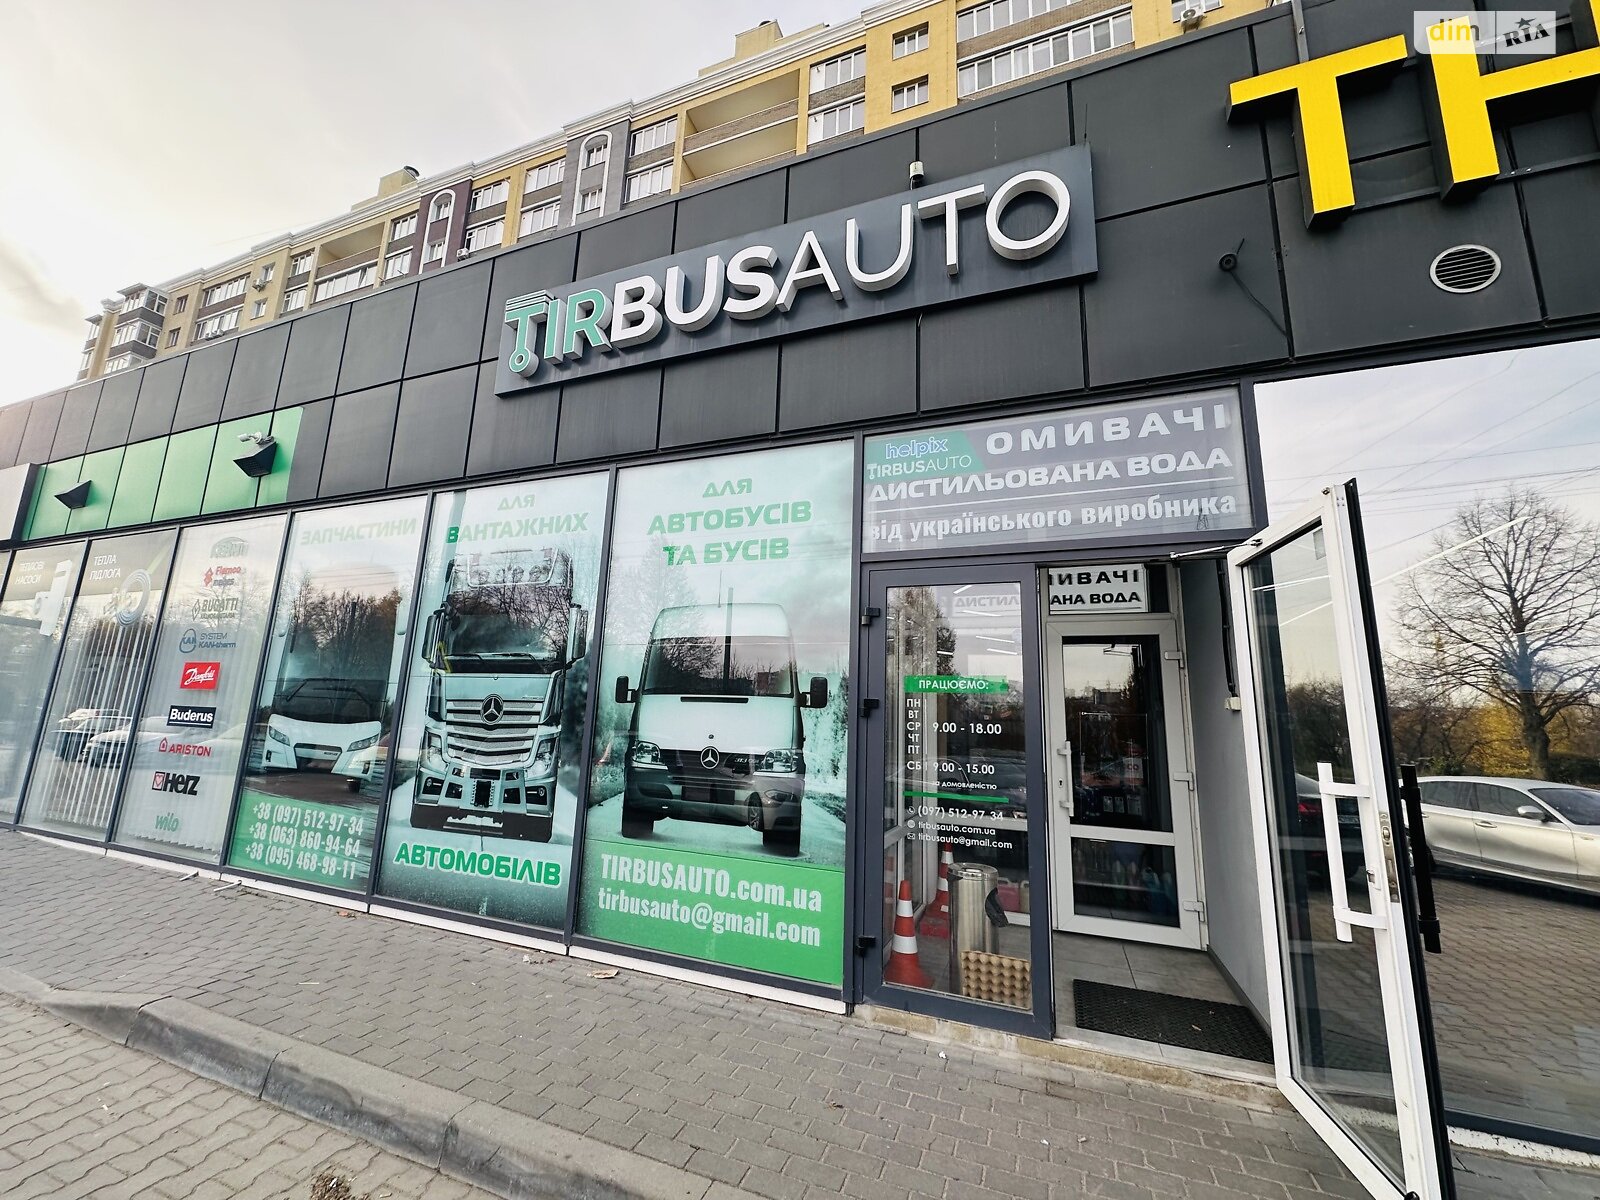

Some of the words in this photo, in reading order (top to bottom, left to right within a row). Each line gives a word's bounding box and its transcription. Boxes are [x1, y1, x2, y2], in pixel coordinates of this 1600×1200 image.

[504, 169, 1071, 378] TIRBUSAUTO
[987, 404, 1226, 455] ОМИВАЧІ
[885, 437, 948, 459] helpix
[866, 455, 972, 480] TIRBUSAUTO
[868, 460, 1121, 502] ДИСТИЛЬОВАНА
[1127, 447, 1233, 477] ВОДА
[702, 478, 753, 498] ДЛЯ
[497, 494, 536, 511] ДЛЯ
[647, 500, 813, 535] АВТОБУСІВ
[870, 519, 903, 543] від
[910, 508, 1072, 542] українського
[1081, 494, 1237, 527] виробника
[300, 518, 418, 546] ЗАПЧАСТИНИ
[445, 512, 590, 544] ВАНТАЖНИХ
[662, 544, 697, 566] ТА
[703, 537, 790, 564] БУСІВ
[93, 554, 118, 567] ТЕПЛА
[201, 597, 239, 612] BUGATTI
[1089, 592, 1141, 604] ВОДА
[198, 641, 237, 649] KAN-therm
[200, 632, 228, 641] SYSTEM
[918, 679, 989, 690] ПРАЦЮЄМО:
[906, 698, 921, 708] ПН
[169, 708, 214, 722] Buderus
[908, 709, 919, 719] ВТ
[906, 721, 921, 731] СР
[932, 722, 957, 733] 9.00
[969, 723, 1002, 734] 18.00
[908, 733, 920, 743] ЧТ
[168, 743, 212, 757] ARISTON
[907, 745, 920, 754] ПТ
[906, 760, 922, 770] СБ
[933, 761, 955, 772] 9.00
[966, 763, 995, 775] 15.00
[253, 802, 271, 820] +38
[272, 804, 302, 828] (097)
[303, 809, 364, 836] 512-97-34
[918, 805, 945, 819] (097)
[155, 812, 180, 832] wilo
[918, 821, 996, 835] tirbusauto.com.ua
[249, 821, 267, 840] +38
[268, 824, 297, 848] (063)
[300, 830, 361, 858] 860-94-64
[918, 832, 1013, 849] tirbusauto@gmail.com
[245, 841, 264, 860] +38
[265, 845, 294, 870] (095)
[296, 851, 357, 880] 468-98-11
[393, 841, 562, 888] АВТОМОБІЛІВ
[600, 853, 822, 913] TIRBUSAUTO.com.ua
[597, 887, 821, 947] tirbusauto@gmail.com
